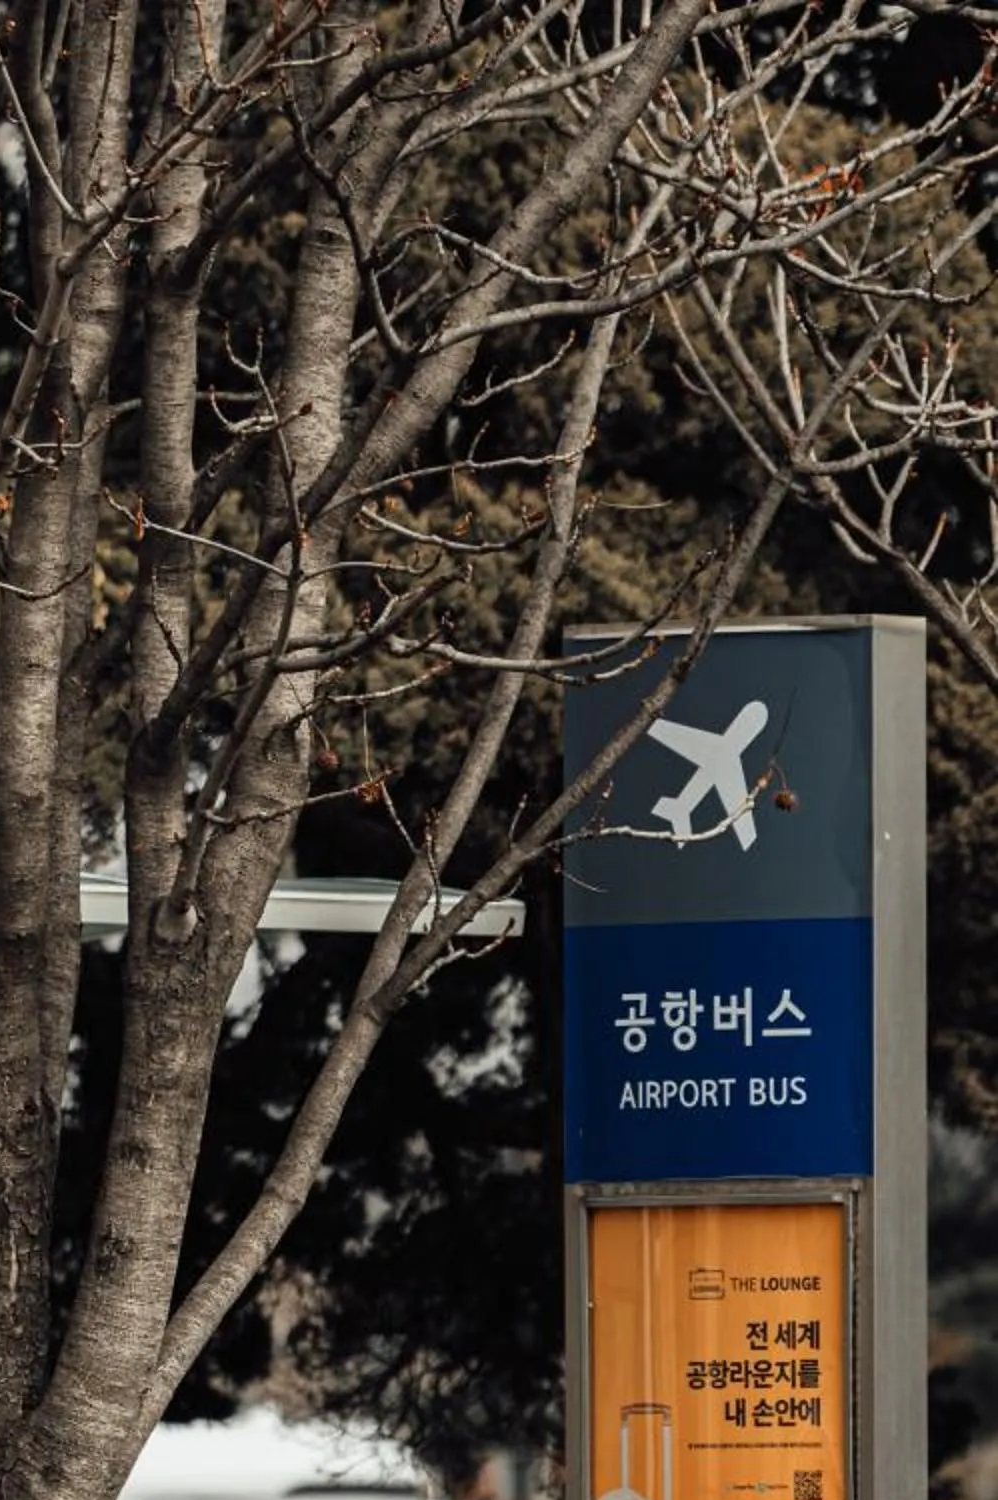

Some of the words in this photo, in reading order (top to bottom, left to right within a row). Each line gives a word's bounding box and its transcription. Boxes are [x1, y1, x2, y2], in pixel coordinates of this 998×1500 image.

[614, 986, 813, 1053] 공항버스
[619, 1078, 737, 1109] AIRPORT
[748, 1076, 808, 1106] BUS
[730, 1277, 757, 1291] THE
[760, 1276, 821, 1291] LOUNGE
[746, 1321, 769, 1350] 전
[774, 1320, 820, 1350] 세계
[686, 1359, 822, 1389] 공항라운지를
[724, 1398, 747, 1428] 내
[752, 1398, 821, 1428] 손안에
